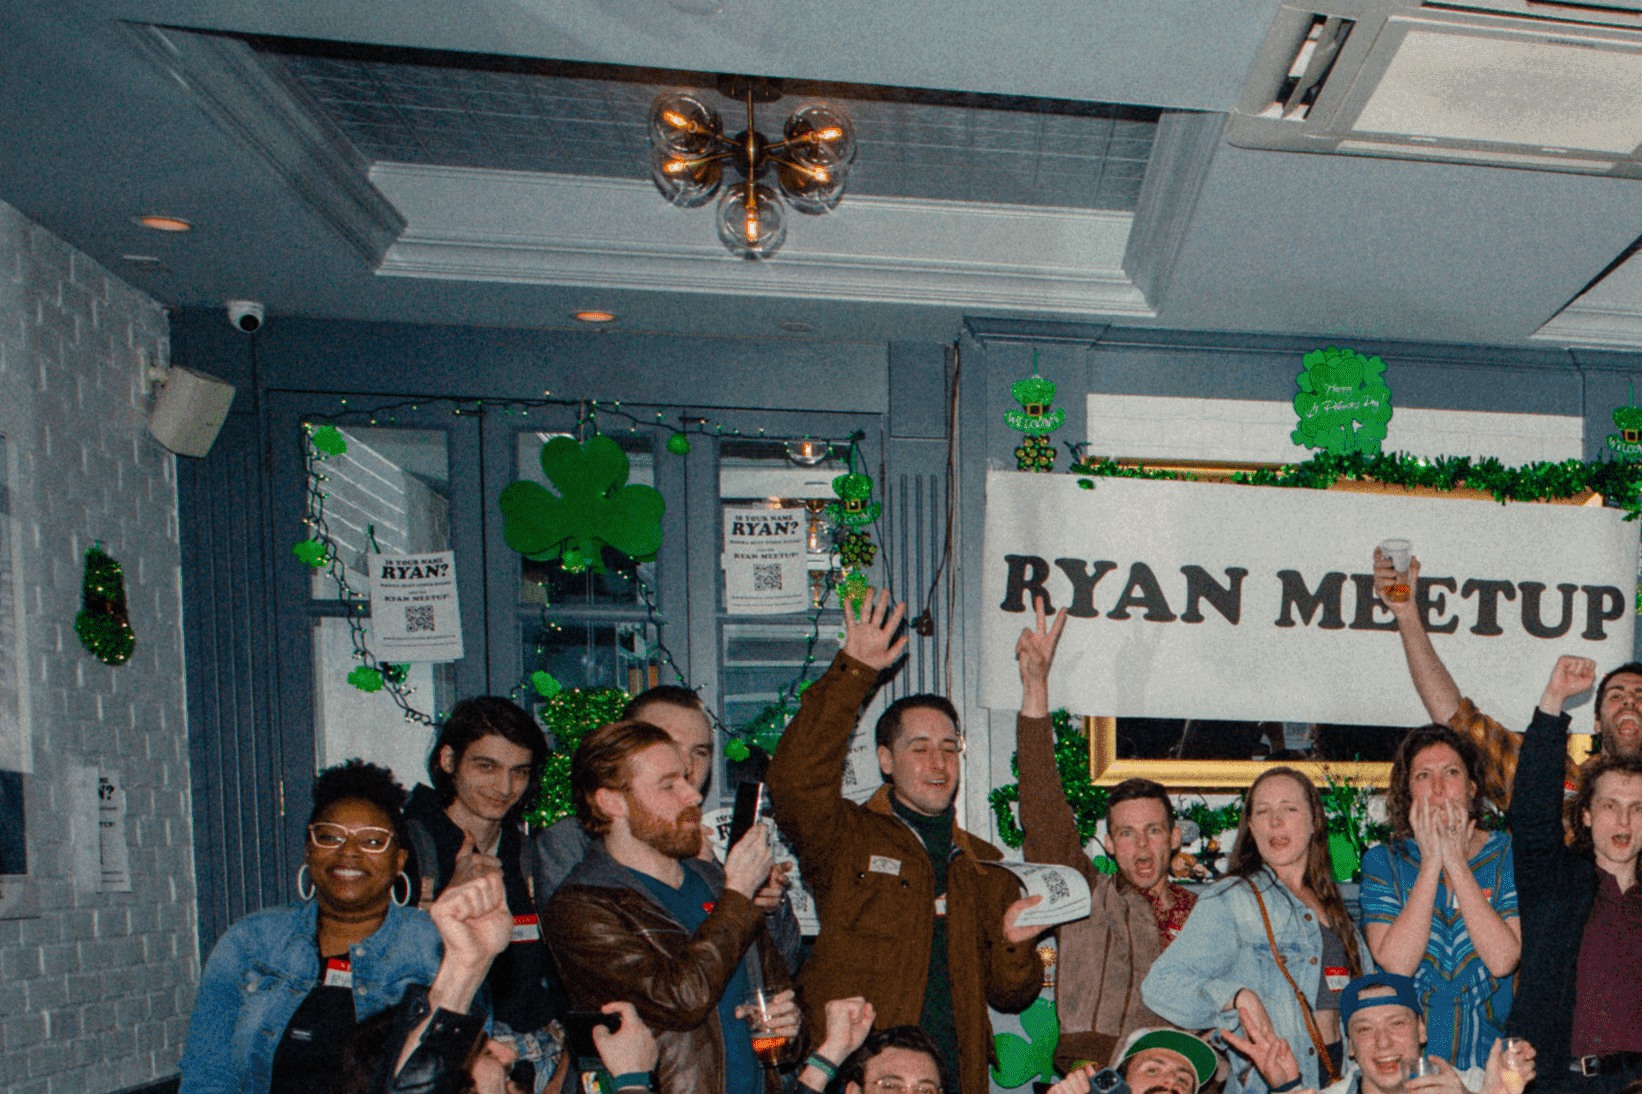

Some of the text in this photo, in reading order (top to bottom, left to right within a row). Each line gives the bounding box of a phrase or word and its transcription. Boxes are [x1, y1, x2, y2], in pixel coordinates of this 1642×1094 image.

[732, 521, 799, 536] RYAN?
[381, 563, 449, 579] RYAN?
[1000, 554, 1626, 642] RYAN MEETUP
